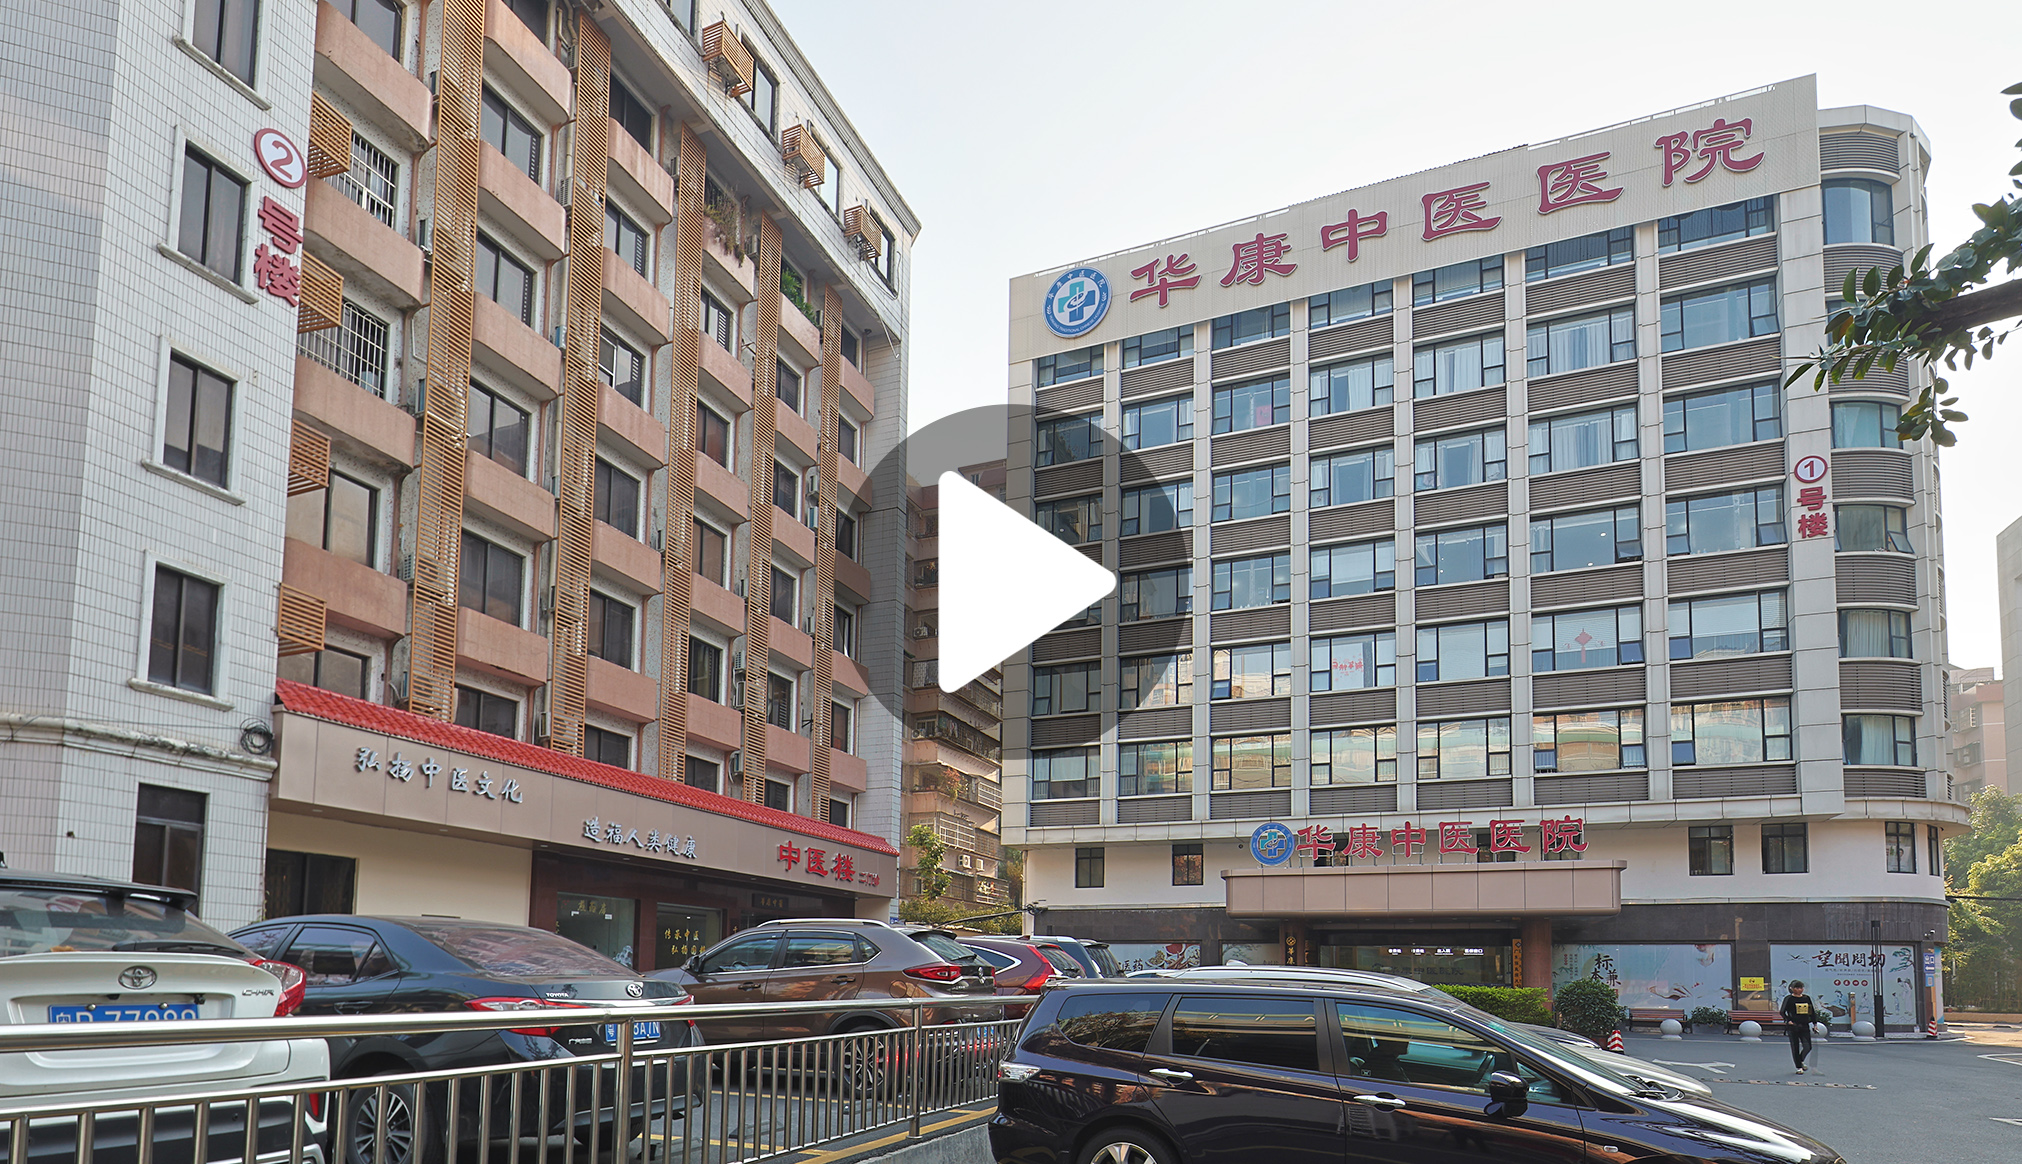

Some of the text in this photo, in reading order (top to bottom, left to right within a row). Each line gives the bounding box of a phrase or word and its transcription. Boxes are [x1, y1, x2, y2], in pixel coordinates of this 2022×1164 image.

[1129, 117, 1766, 309] 华康中医医院
[356, 747, 523, 804] 弘扬中医文化
[583, 816, 698, 859] 造福人类健康
[777, 838, 856, 882] 中医楼
[1295, 814, 1589, 860] 华康中医医院
